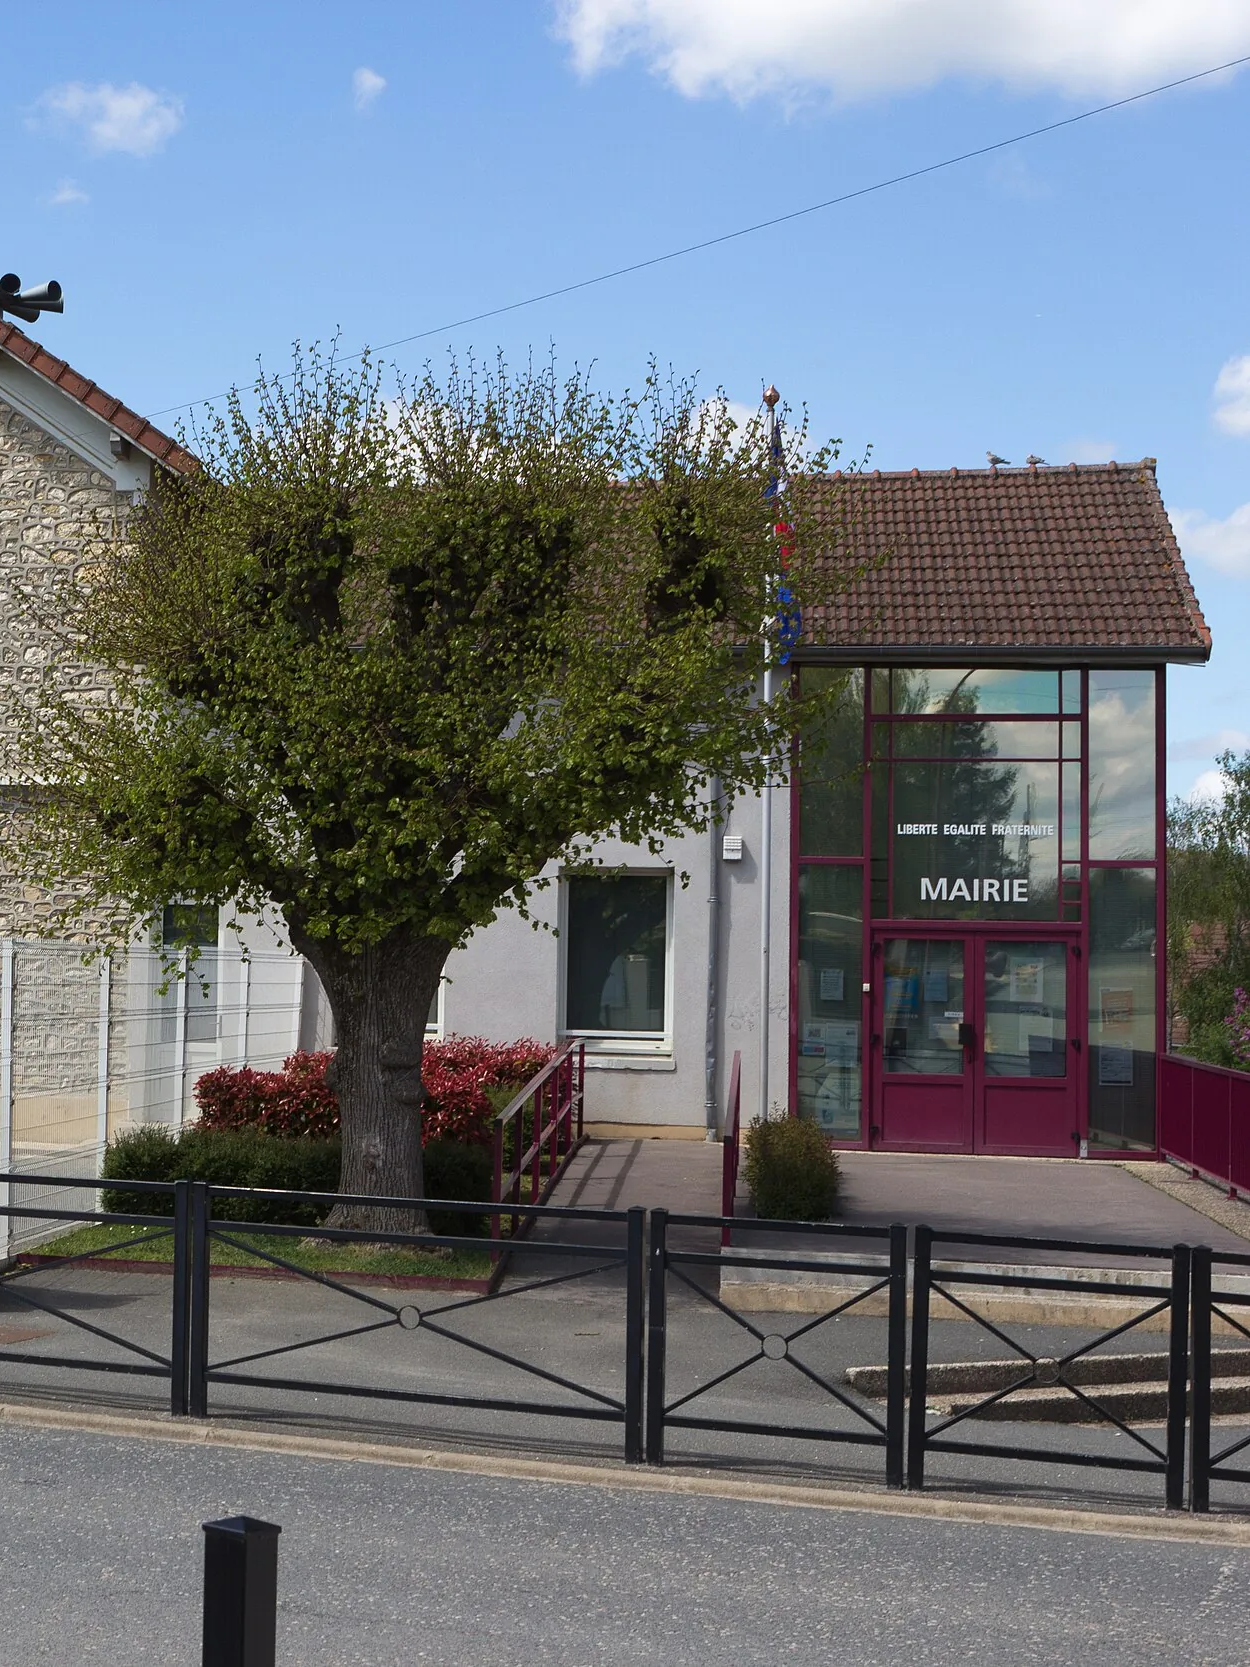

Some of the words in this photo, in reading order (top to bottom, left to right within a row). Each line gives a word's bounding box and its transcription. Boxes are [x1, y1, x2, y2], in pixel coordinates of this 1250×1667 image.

[897, 823, 938, 835] LIBERTE
[943, 824, 986, 836] EGALITE
[991, 824, 1054, 836] FRATERNITE
[920, 877, 1028, 902] MAIRIE
